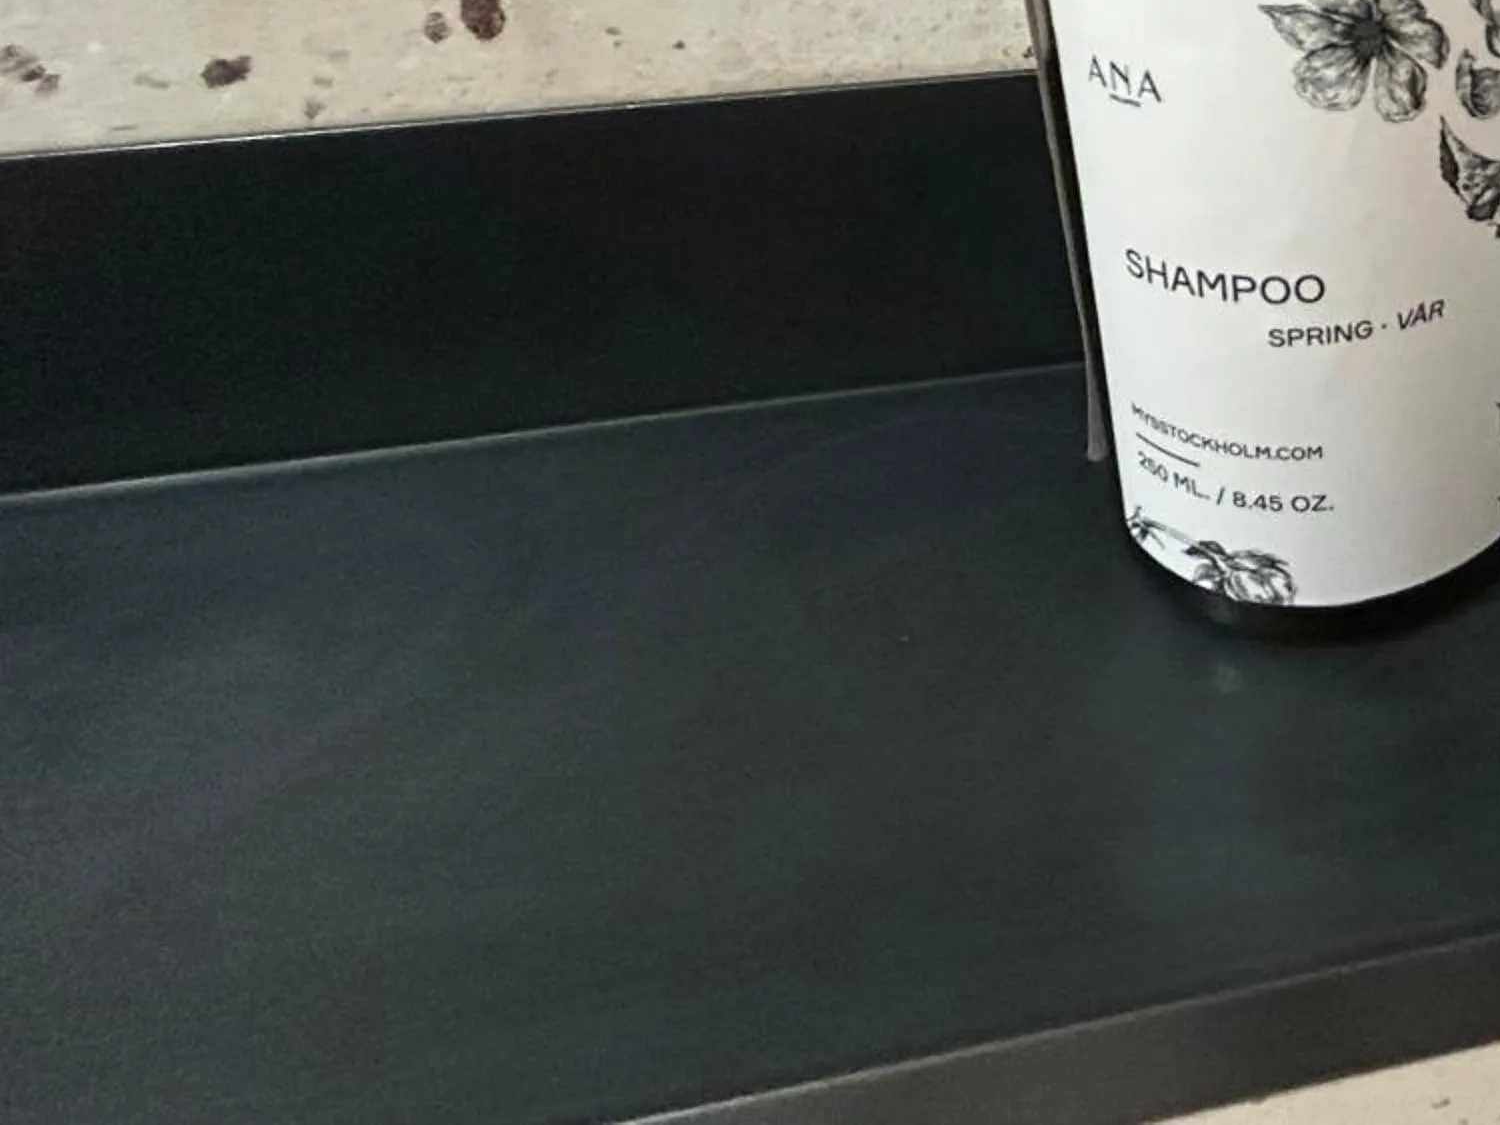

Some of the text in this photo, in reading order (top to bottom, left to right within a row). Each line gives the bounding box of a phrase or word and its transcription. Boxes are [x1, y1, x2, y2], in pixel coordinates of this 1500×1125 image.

[1088, 55, 1162, 104] ANA
[1125, 248, 1327, 307] SHAMPOO
[1268, 320, 1375, 348] SPRING
[1131, 402, 1324, 462] MYSSTOCKHOLM.COM
[1137, 450, 1169, 484] 250
[1216, 486, 1227, 506] /
[1232, 491, 1286, 514] 8.45
[1289, 494, 1335, 514] OZ.
